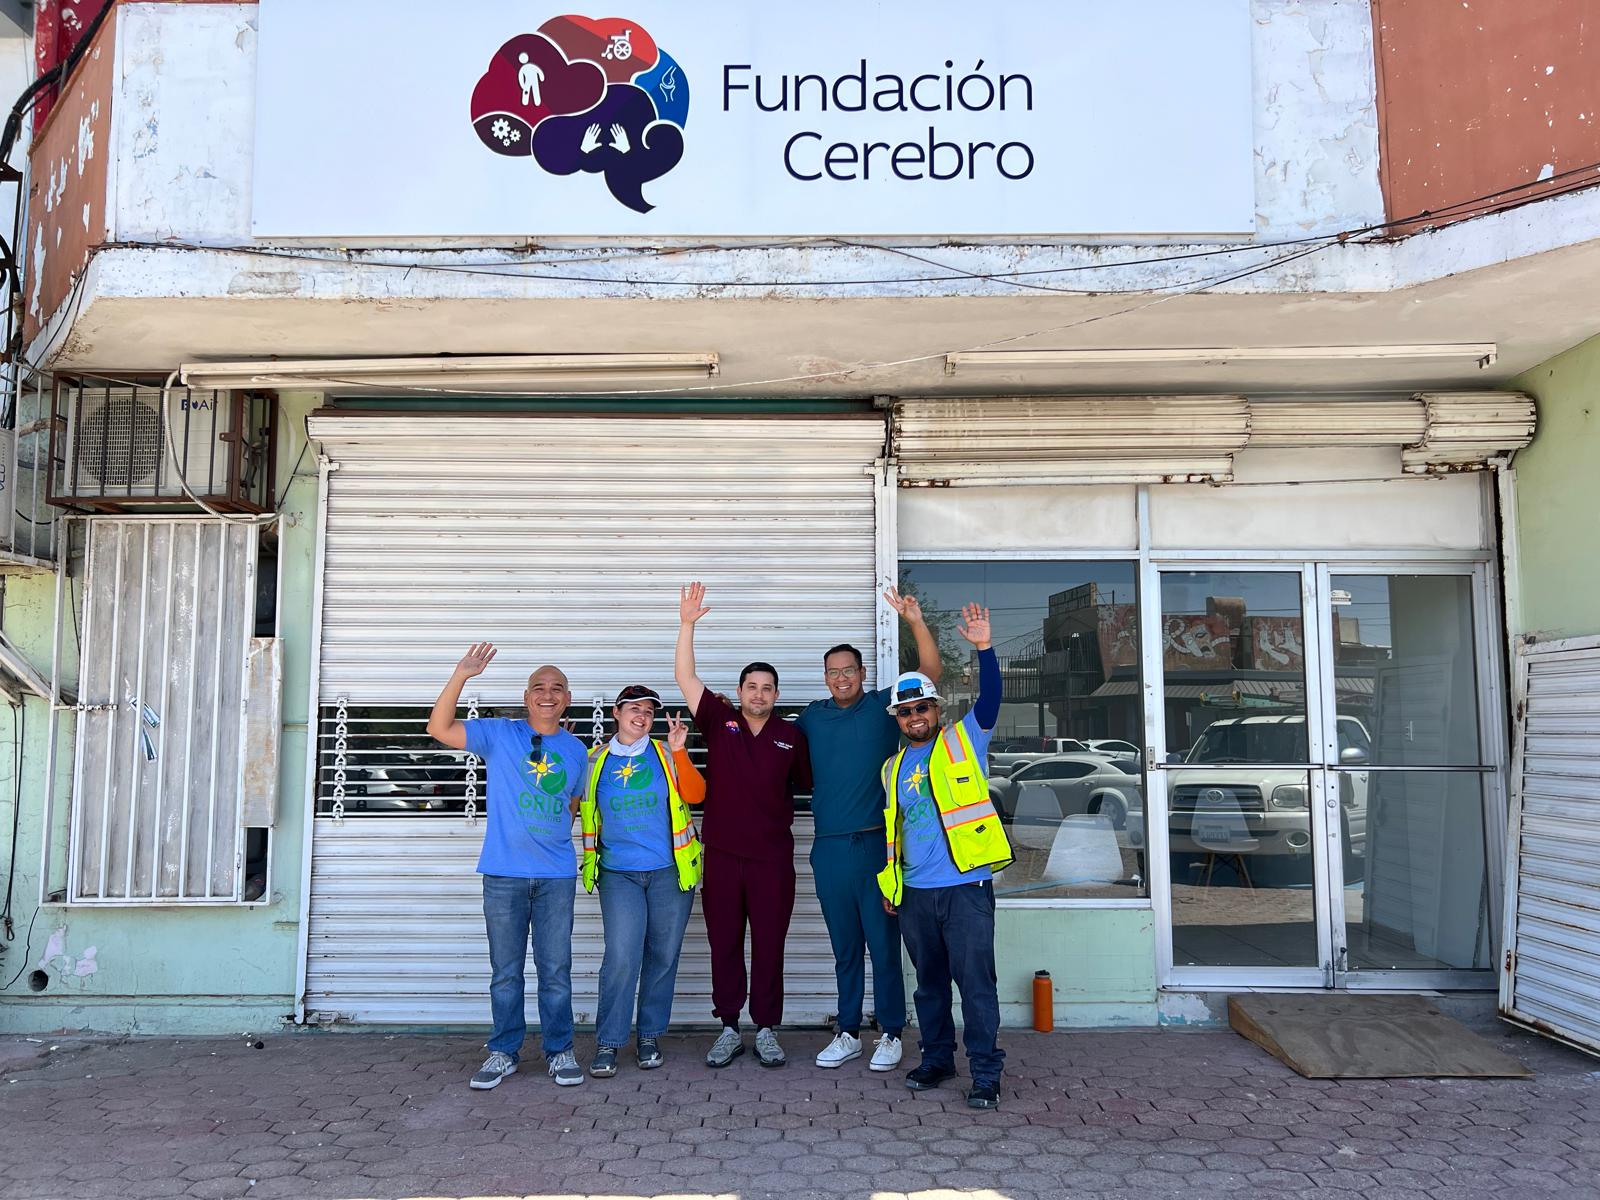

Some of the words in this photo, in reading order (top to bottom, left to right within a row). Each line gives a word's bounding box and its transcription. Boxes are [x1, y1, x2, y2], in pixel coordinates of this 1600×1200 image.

[723, 58, 1033, 112] Fundación
[783, 126, 1035, 181] Cerebro
[518, 791, 564, 815] GRID
[609, 791, 658, 811] GRID
[907, 800, 936, 824] GRI
